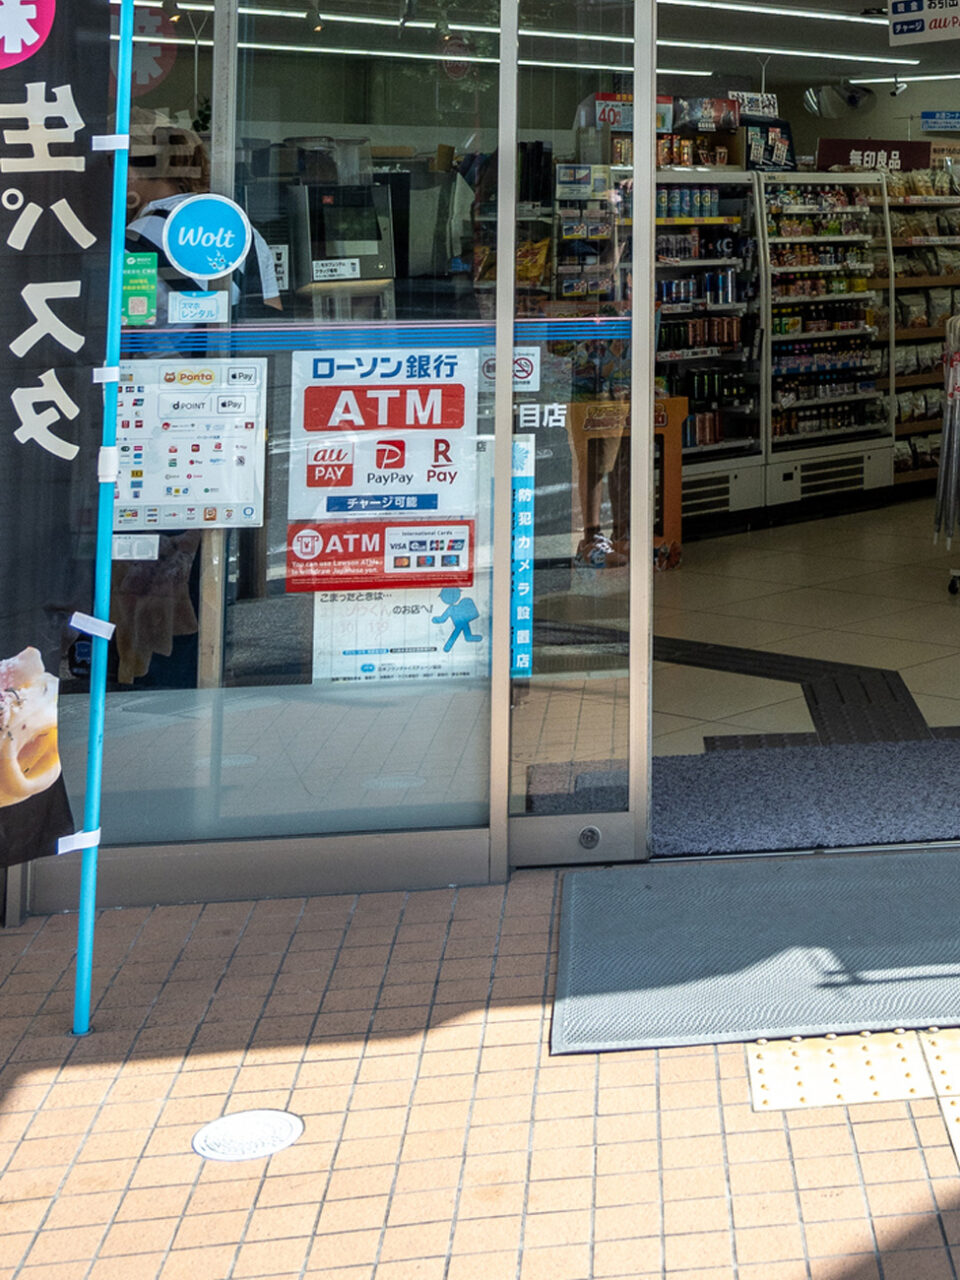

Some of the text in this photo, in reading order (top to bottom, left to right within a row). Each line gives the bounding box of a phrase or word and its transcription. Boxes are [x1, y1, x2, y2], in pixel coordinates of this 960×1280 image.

[894, 22, 923, 34] チャージ
[178, 226, 236, 249] Wolt
[181, 301, 201, 310] スマホ
[180, 309, 216, 319] レンタル
[312, 354, 459, 380] ローソン銀行
[179, 372, 254, 382] Ponta Pay
[226, 400, 242, 410] Pay
[327, 388, 443, 427] ATM
[517, 404, 568, 429] 目店
[313, 448, 349, 463] au
[314, 466, 346, 481] PAY
[366, 472, 414, 486] PayPay
[426, 469, 458, 485] Pay
[346, 494, 418, 510] チャージ可能
[325, 533, 381, 553] ATM
[389, 542, 407, 551] VISA
[516, 487, 533, 669] 防犯カメラ設置店
[392, 604, 434, 616] のお店へ!
